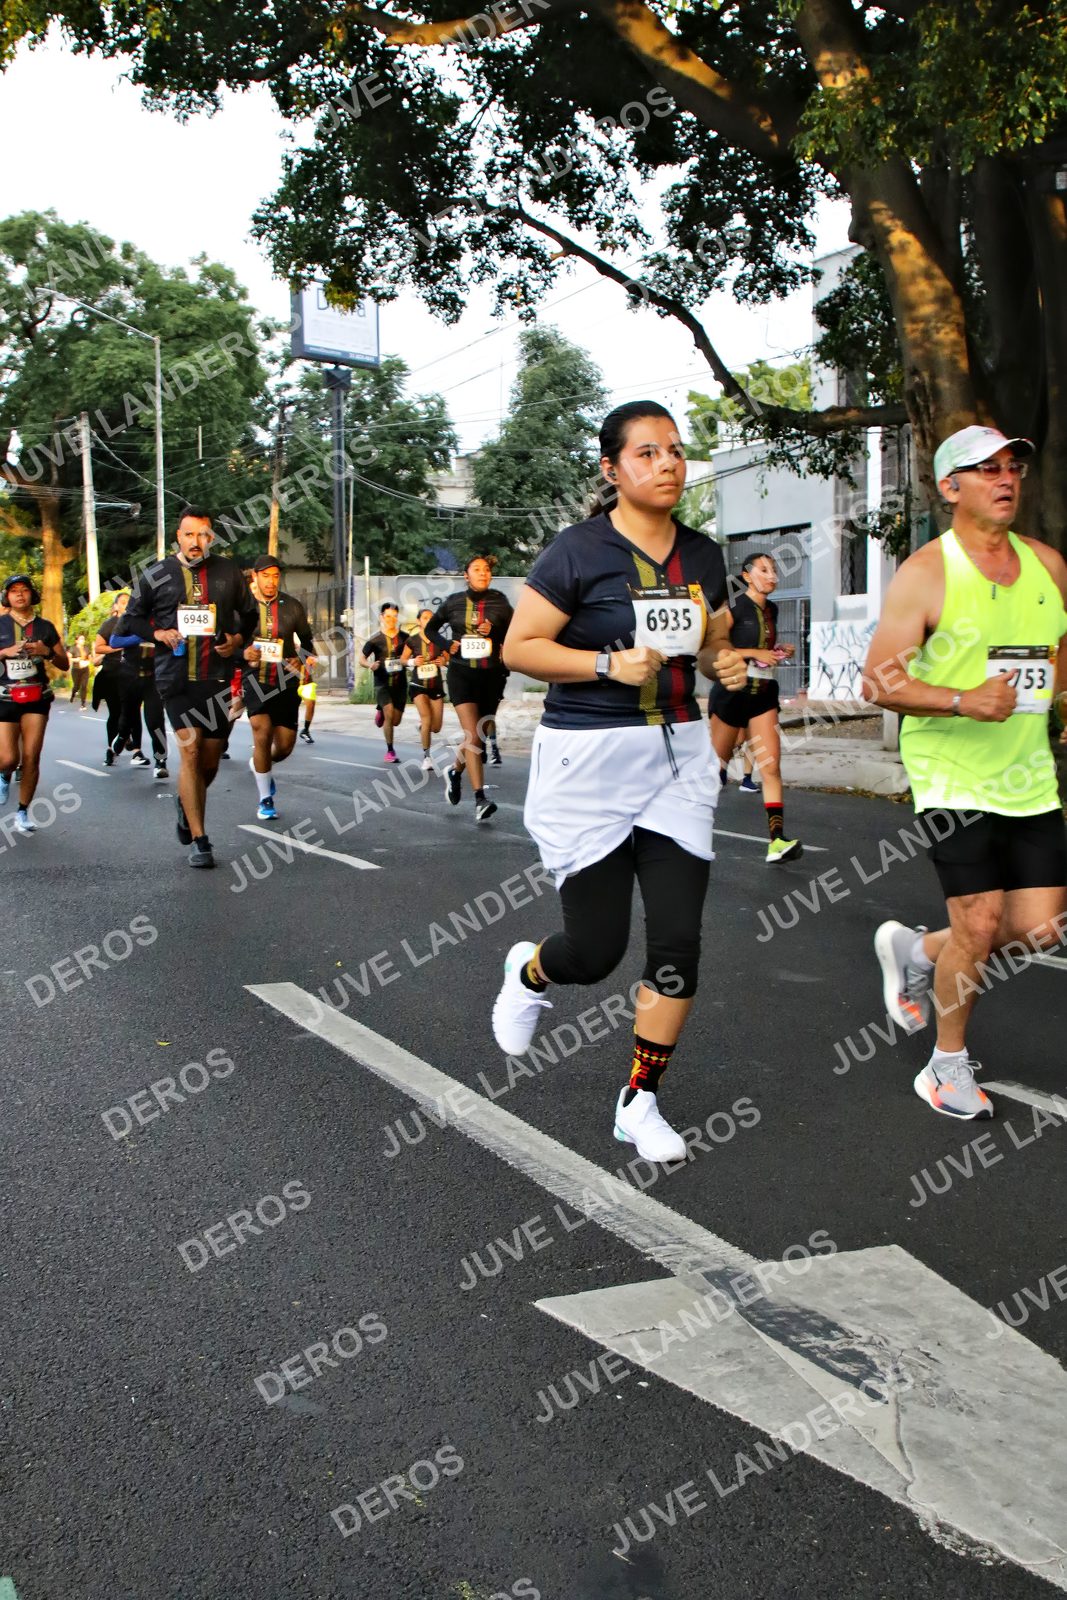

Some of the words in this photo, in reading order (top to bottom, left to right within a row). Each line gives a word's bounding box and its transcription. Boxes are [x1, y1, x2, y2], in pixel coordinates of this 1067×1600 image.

[184, 614, 209, 624] 6948
[646, 608, 692, 632] 6935
[466, 641, 486, 649] 3520
[10, 660, 33, 671] 7304
[999, 668, 1046, 690] 753
